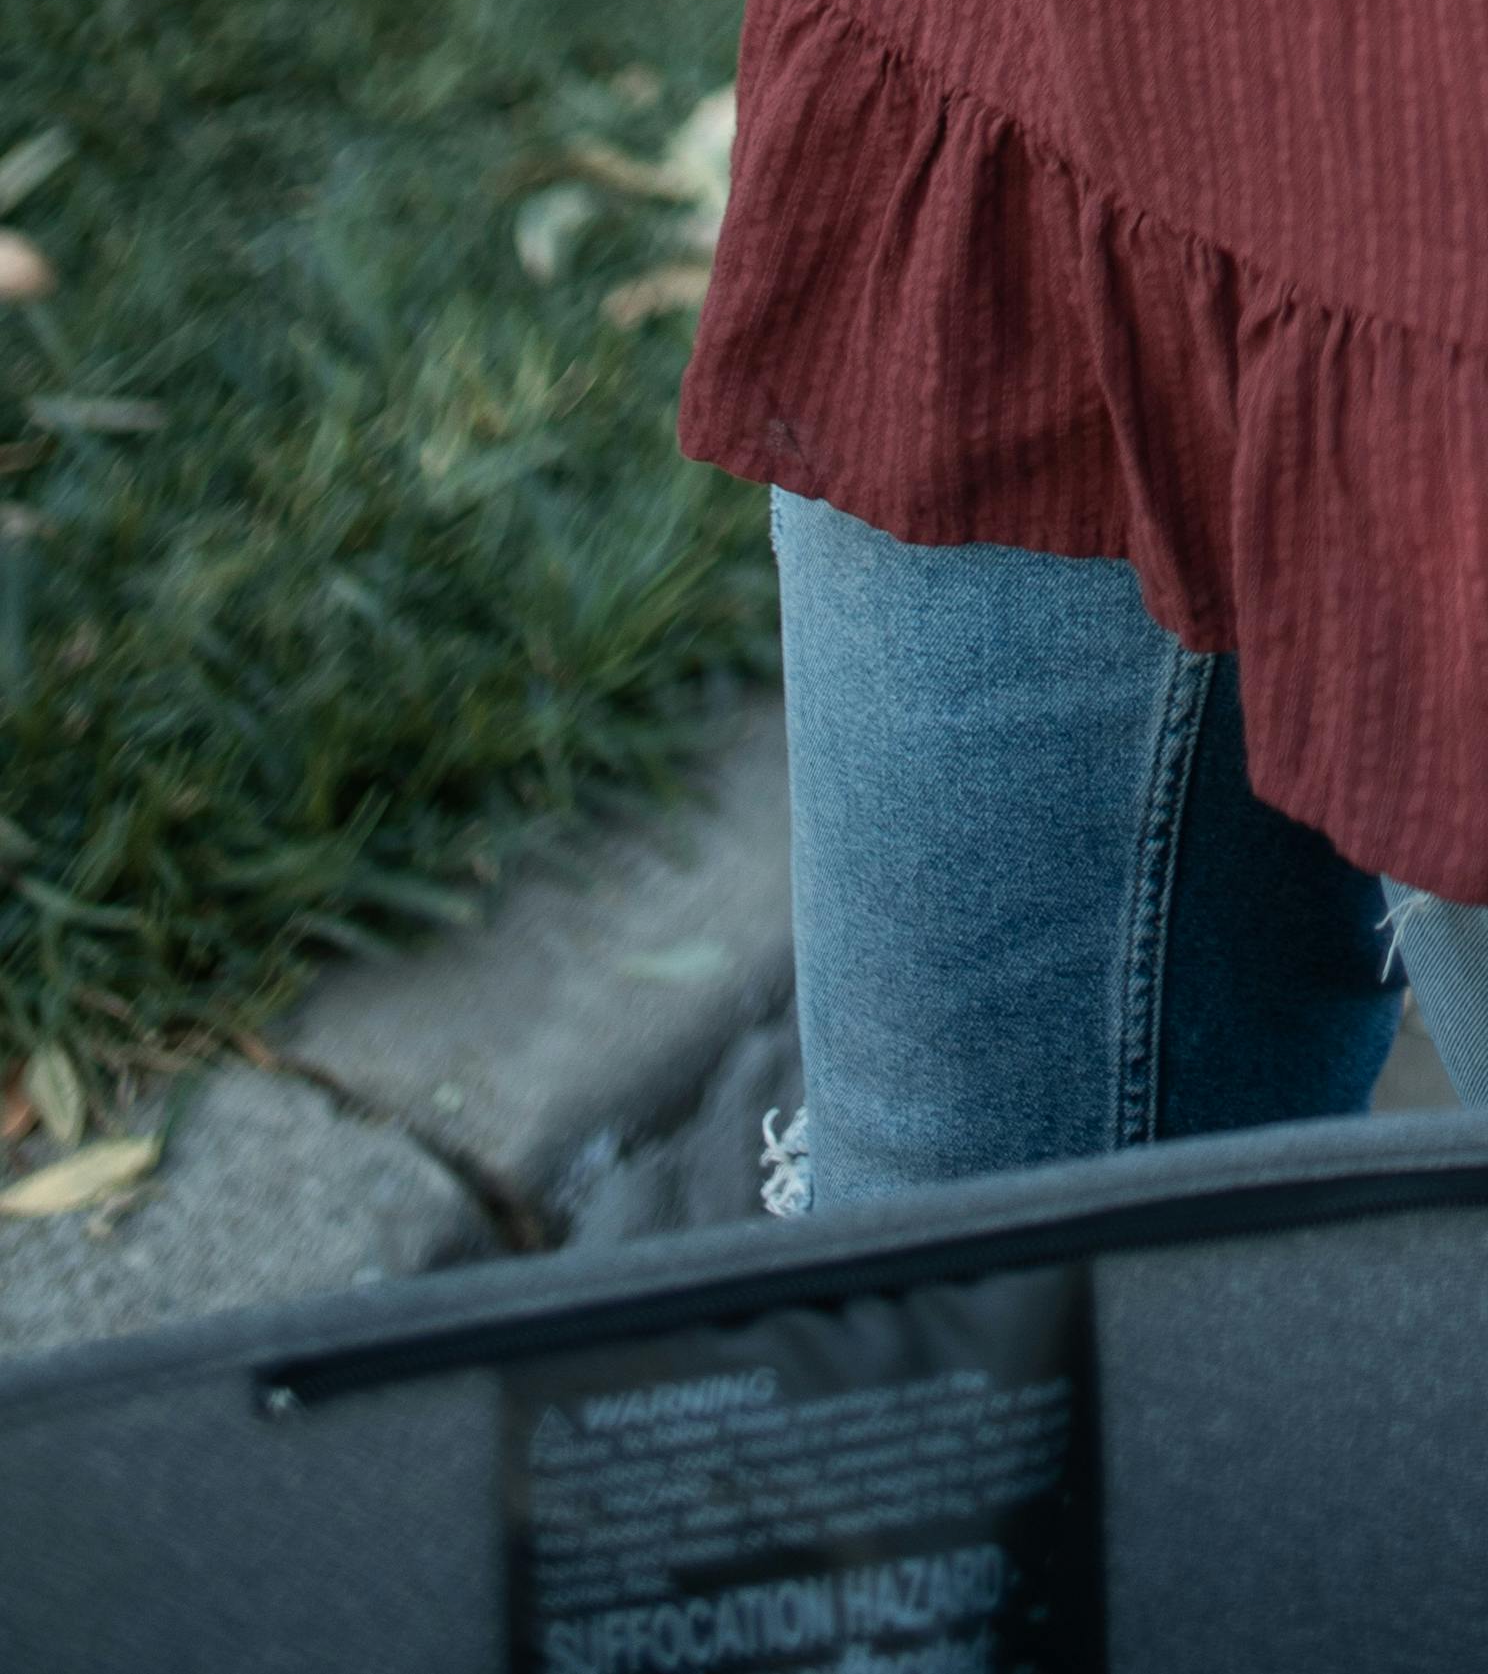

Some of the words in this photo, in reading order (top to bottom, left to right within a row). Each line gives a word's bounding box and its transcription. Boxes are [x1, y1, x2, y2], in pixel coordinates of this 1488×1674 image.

[584, 1369, 775, 1429] WARNING
[549, 1577, 836, 1674] SUFFOCATION
[844, 1543, 998, 1630] HAZARD
